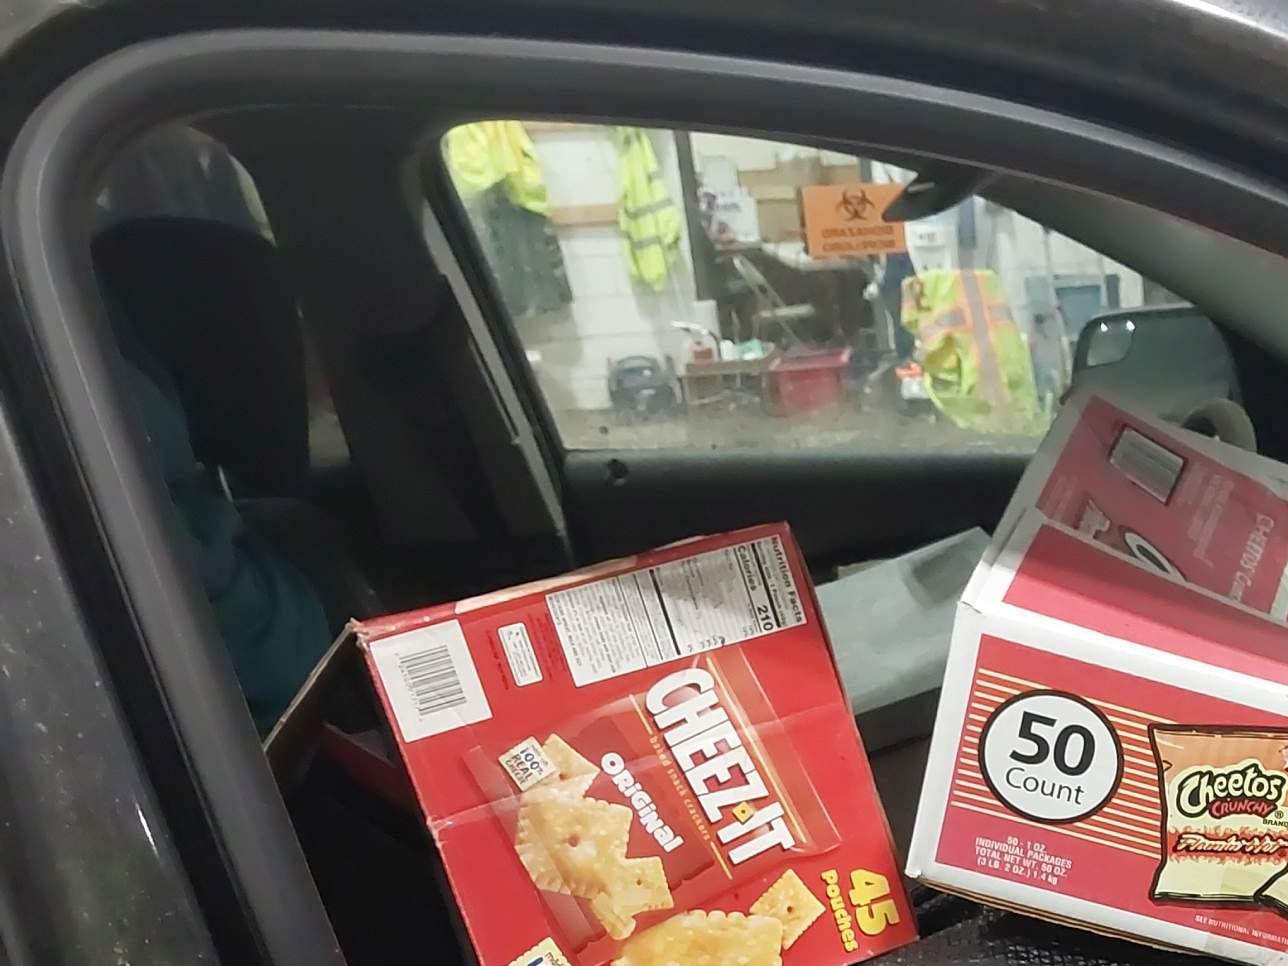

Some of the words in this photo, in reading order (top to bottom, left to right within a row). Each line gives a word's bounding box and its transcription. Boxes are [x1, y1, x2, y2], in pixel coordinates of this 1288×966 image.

[738, 545, 757, 592] Calories
[757, 604, 774, 631] 210
[772, 537, 792, 588] Nutrition
[788, 591, 803, 622] Facts
[511, 753, 533, 779] REAL
[1009, 710, 1096, 777] 50
[649, 736, 673, 767] baked
[667, 767, 686, 797] snack
[683, 797, 711, 841] crackers
[1005, 766, 1085, 805] Count
[1177, 763, 1286, 818] Cheetos
[1210, 799, 1275, 818] CRUNCHY
[975, 845, 1001, 860] TOTAL
[1003, 854, 1021, 865] NET
[976, 837, 1024, 857] INDIVIDUAL
[1026, 850, 1072, 869] PACKAGES
[820, 868, 859, 953] Pouches
[848, 868, 901, 936] 45
